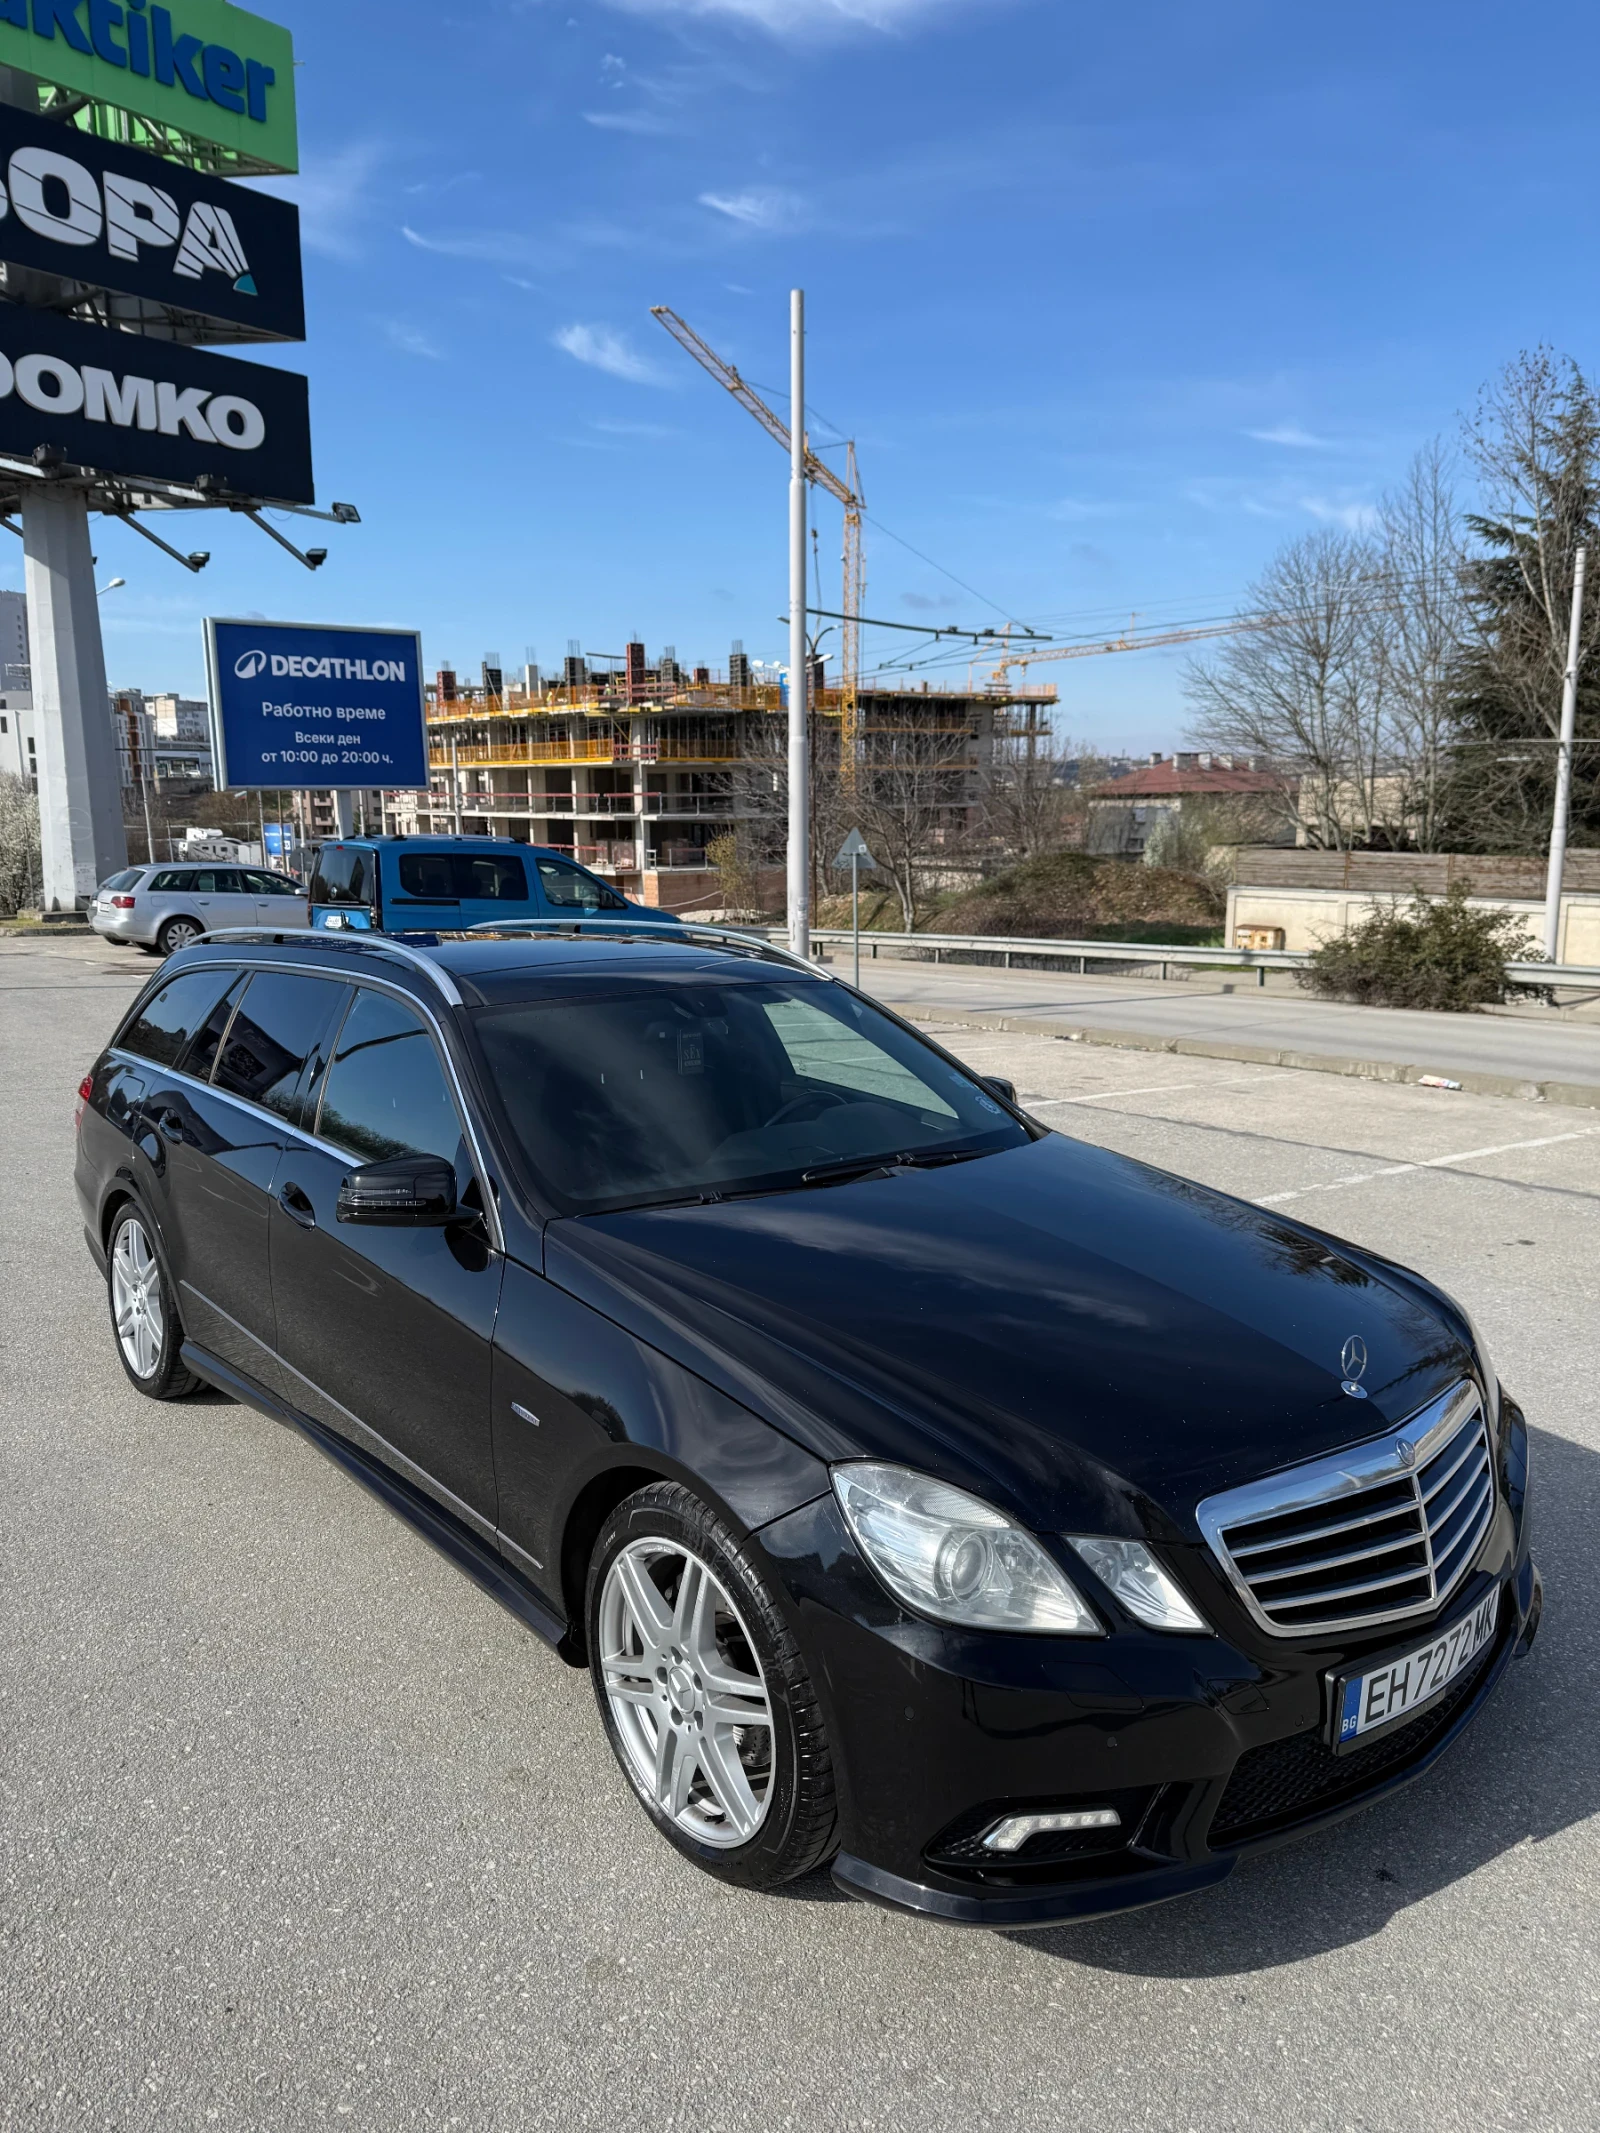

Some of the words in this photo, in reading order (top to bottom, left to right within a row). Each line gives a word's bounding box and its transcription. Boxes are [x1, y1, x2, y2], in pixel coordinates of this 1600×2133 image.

[0, 0, 275, 122] ktiker
[0, 147, 258, 296] ОРА
[0, 350, 265, 450] OMKO
[270, 655, 406, 682] DECATHLON
[262, 702, 332, 719] Работно
[336, 705, 386, 722] време
[295, 731, 335, 744] Всеки
[337, 734, 361, 746] ден
[261, 753, 277, 763] от
[280, 750, 318, 763] 10:00
[321, 753, 338, 765] до
[342, 752, 380, 764] 20:00
[382, 754, 394, 764] ч.
[1342, 1715, 1357, 1733] BG
